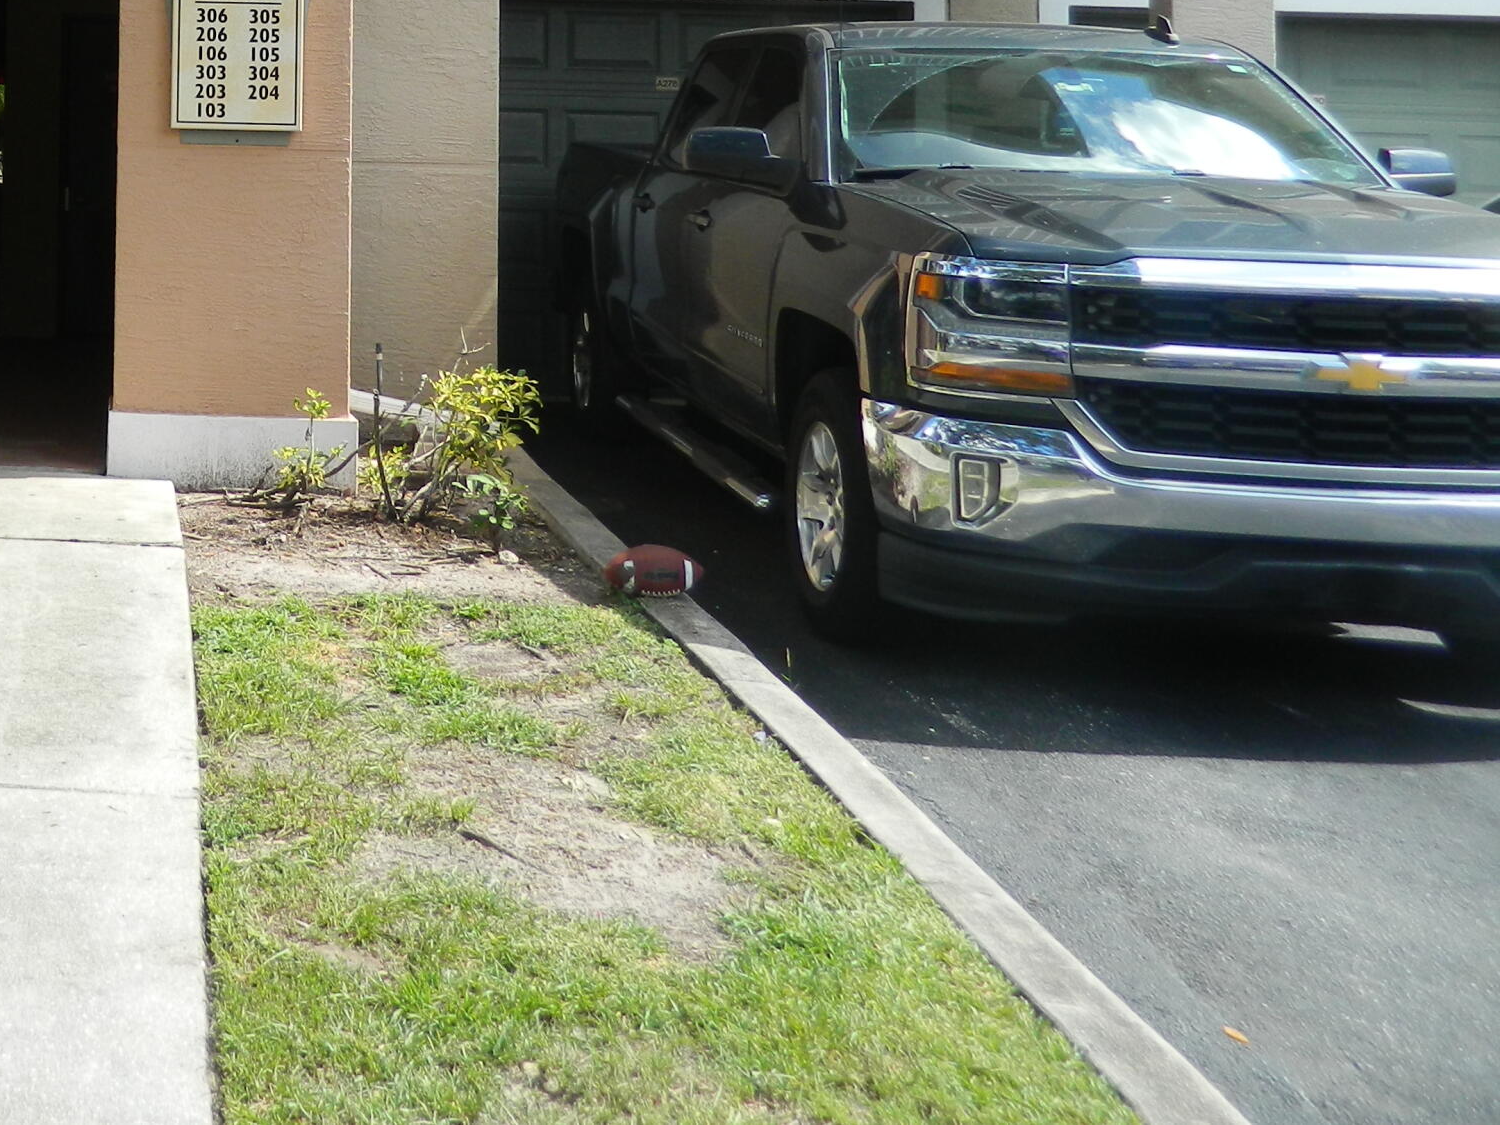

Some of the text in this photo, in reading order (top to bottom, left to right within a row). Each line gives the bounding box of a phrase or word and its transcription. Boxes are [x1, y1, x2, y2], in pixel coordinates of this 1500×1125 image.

[196, 7, 281, 25] 306 305
[195, 26, 280, 44] 206 205
[198, 45, 280, 63] 106 105
[195, 64, 280, 82] 303 304
[195, 83, 280, 101] 203 204
[197, 102, 226, 119] 103
